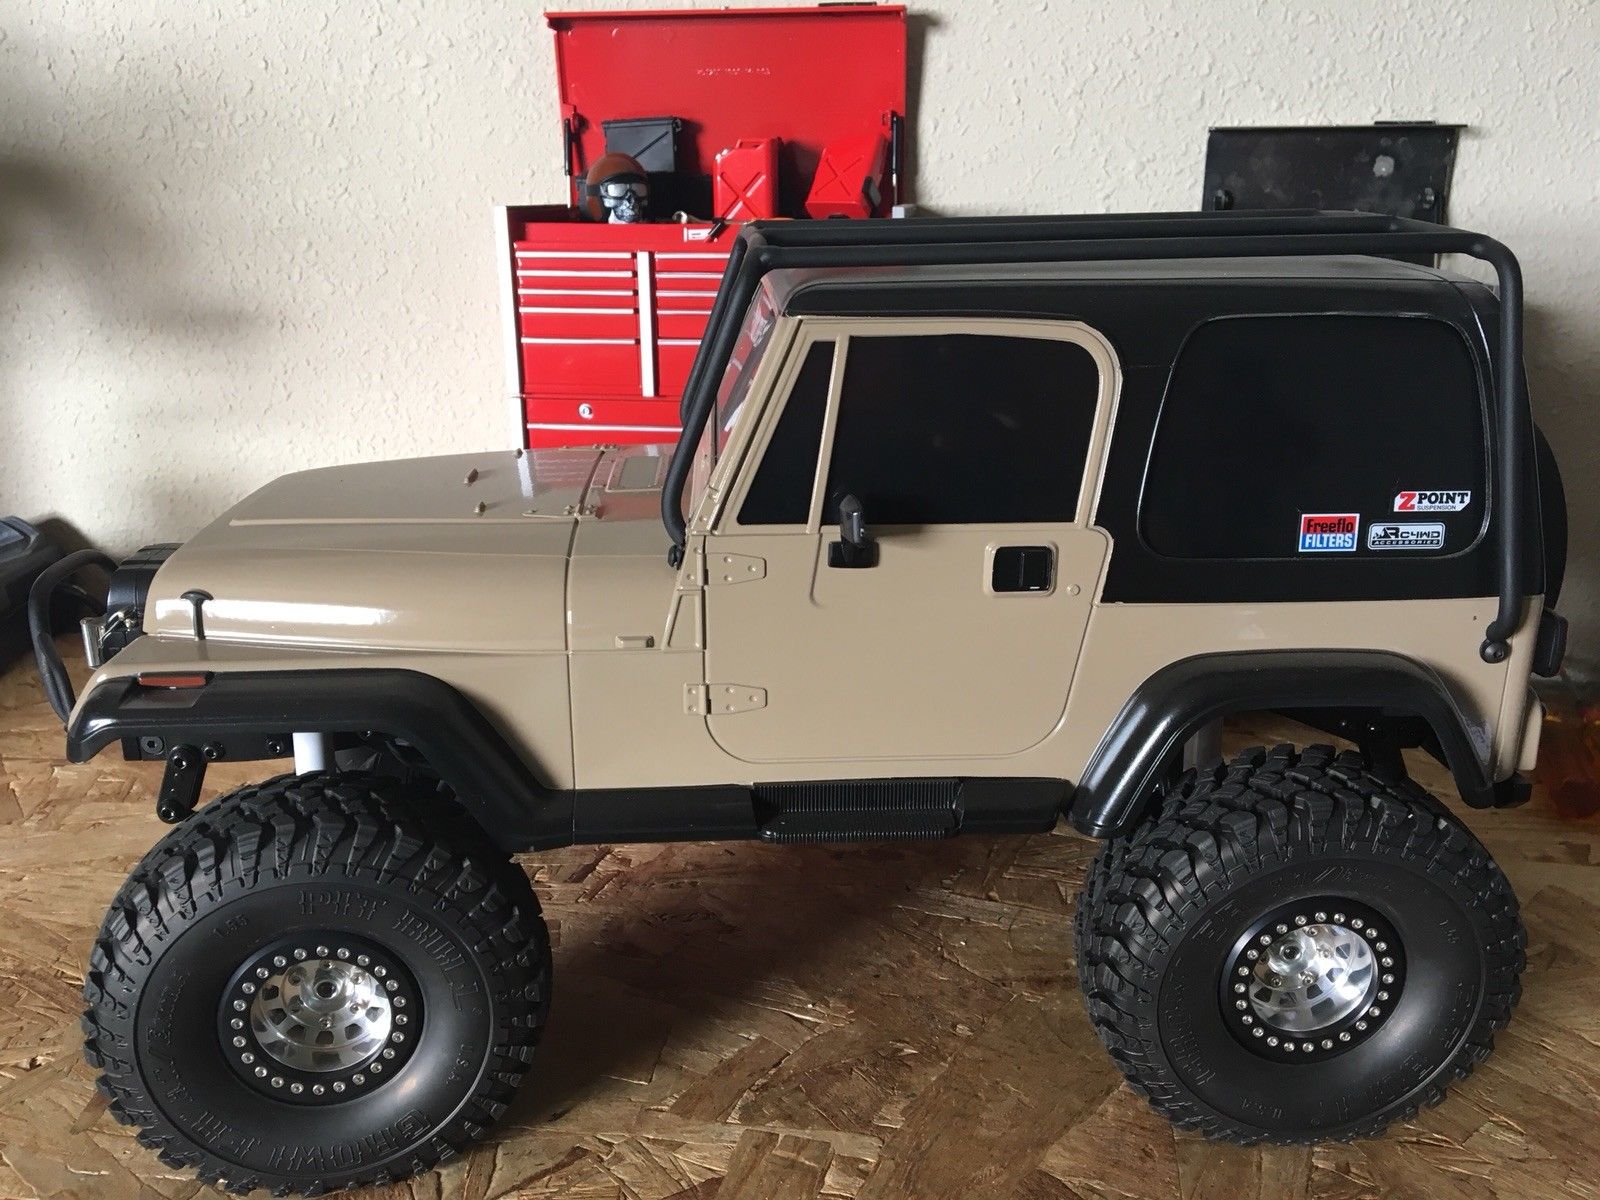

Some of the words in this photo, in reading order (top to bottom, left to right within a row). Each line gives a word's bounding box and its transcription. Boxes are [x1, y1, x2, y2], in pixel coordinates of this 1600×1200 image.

[1399, 492, 1417, 510] Z
[1417, 492, 1469, 505] POINT
[1306, 518, 1354, 534] Freeflo
[1304, 533, 1353, 548] FILTERS
